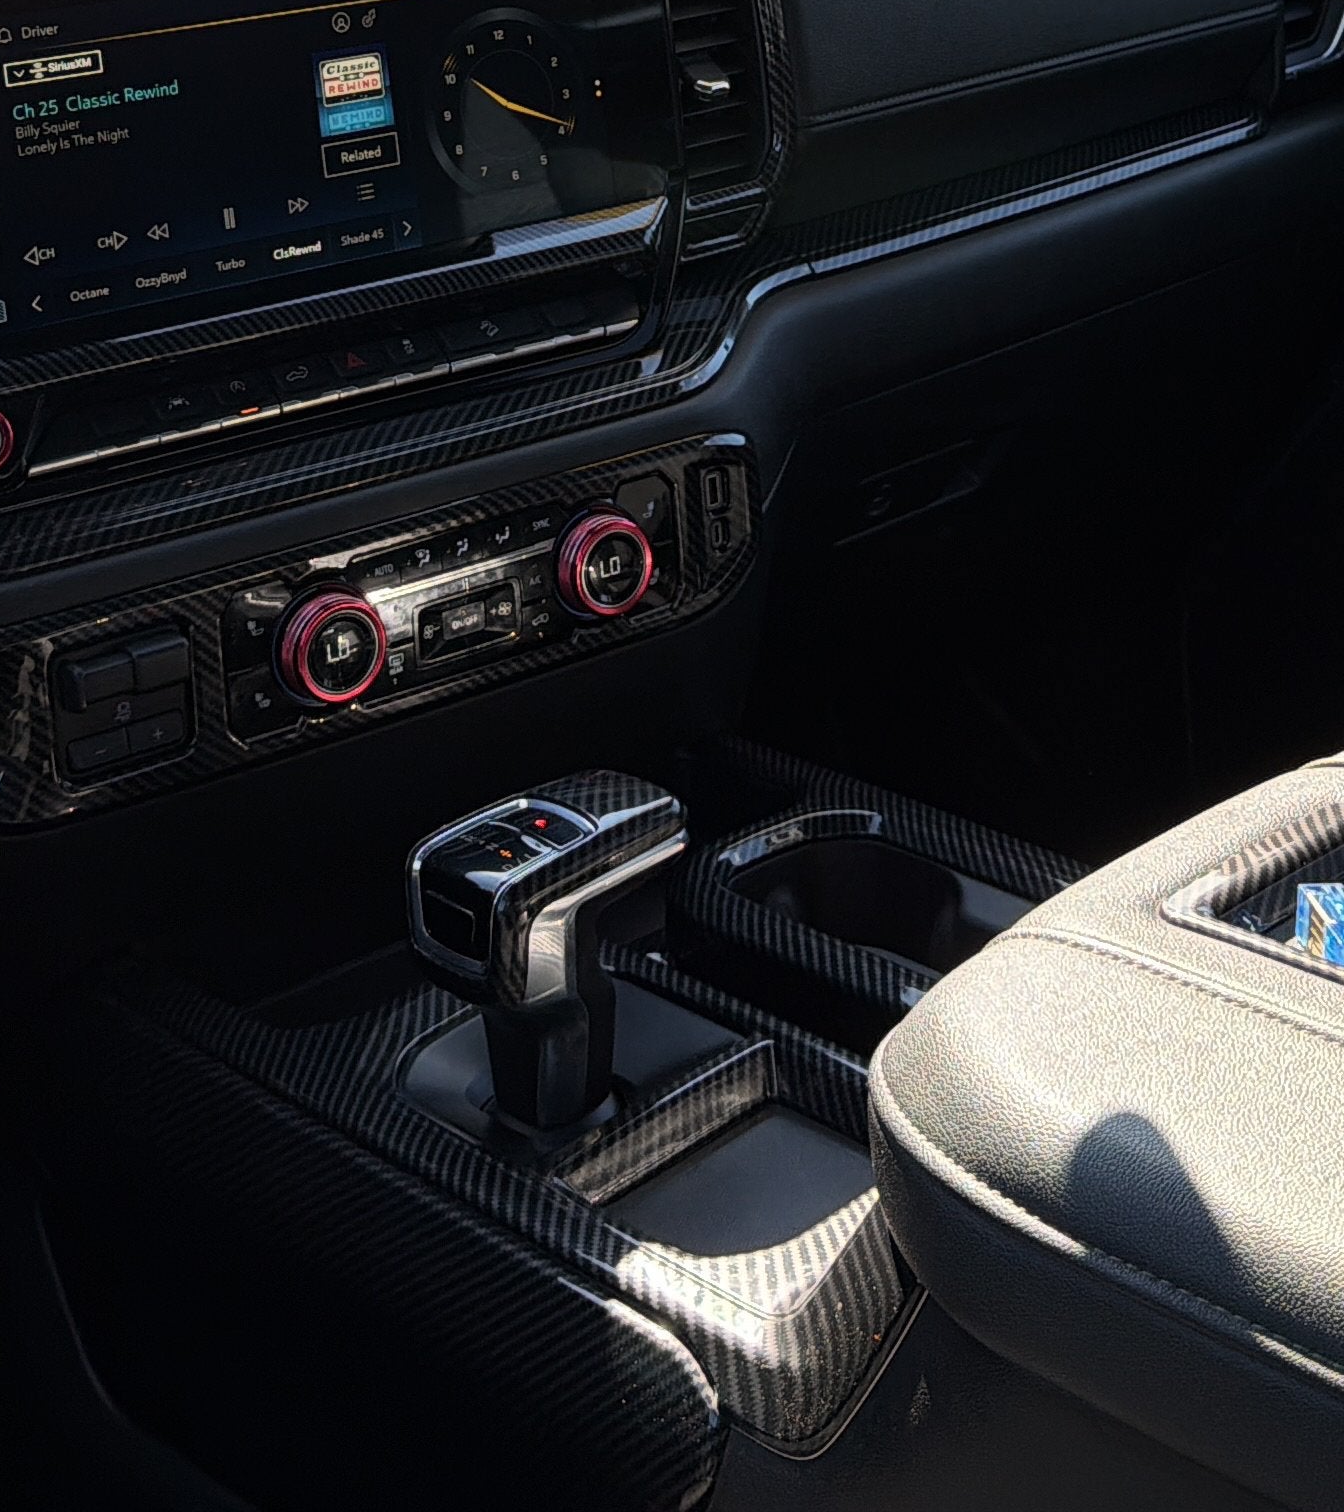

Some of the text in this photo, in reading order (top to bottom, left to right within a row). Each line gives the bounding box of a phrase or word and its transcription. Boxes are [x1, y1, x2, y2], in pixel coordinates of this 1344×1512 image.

[21, 24, 59, 40] Driver
[493, 30, 504, 41] 12
[527, 35, 533, 46] 1
[466, 44, 475, 55] 11
[48, 57, 92, 73] SiriusXM
[326, 60, 376, 75] Classic
[550, 56, 559, 67] 2
[328, 78, 378, 94] REWIND
[444, 74, 456, 85] 10
[13, 79, 179, 121] Ch 25 Classic Rewind
[562, 89, 570, 100] 3
[443, 110, 452, 122] 9
[16, 119, 81, 141] Billy Squier
[17, 128, 130, 157] Lonely Is The Night
[341, 145, 382, 164] Related
[455, 145, 463, 156] 8
[540, 155, 548, 166] 5
[480, 166, 488, 177] 7
[512, 170, 520, 181] 6
[341, 229, 385, 247] Shade 45
[273, 241, 322, 261] ClsRewnd
[216, 258, 246, 272] Turbo
[135, 269, 187, 288] OzzyBnyd
[70, 286, 110, 302] Octane
